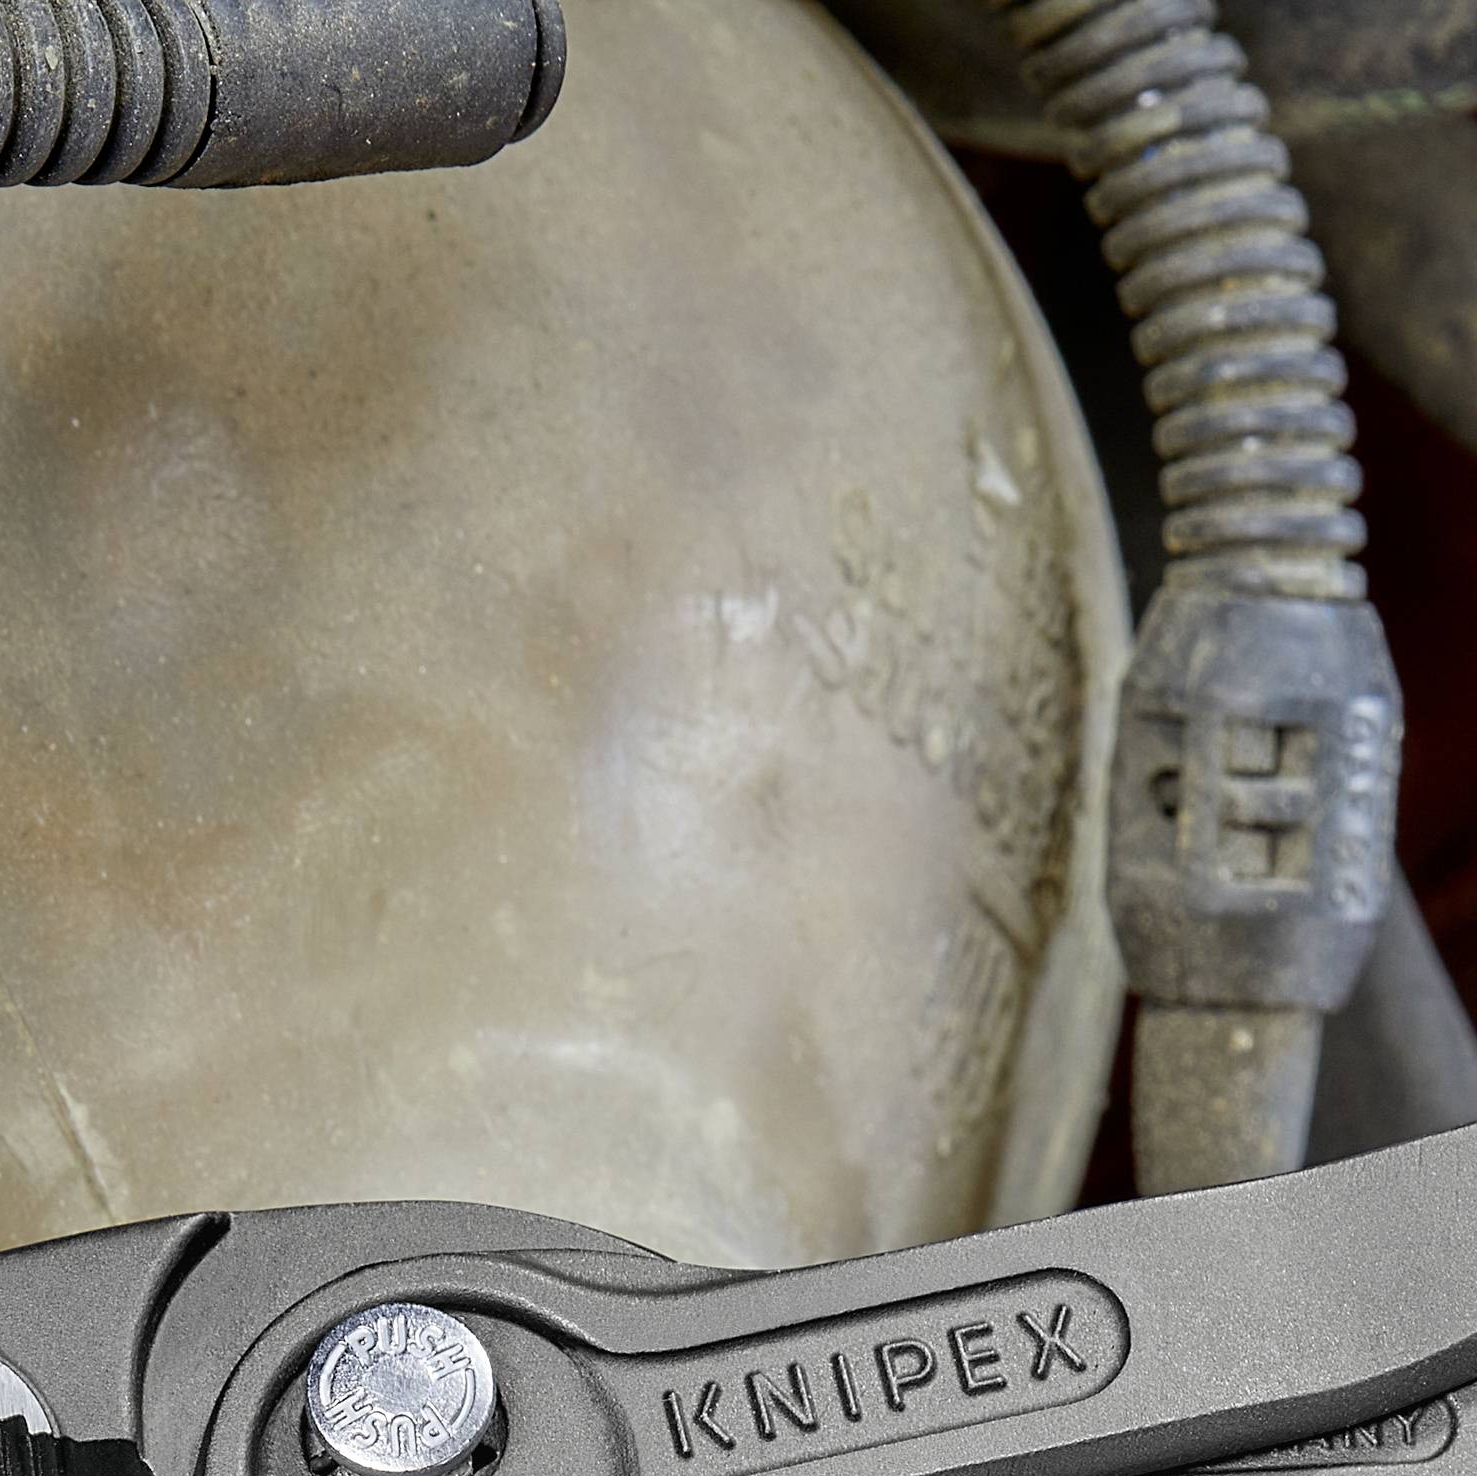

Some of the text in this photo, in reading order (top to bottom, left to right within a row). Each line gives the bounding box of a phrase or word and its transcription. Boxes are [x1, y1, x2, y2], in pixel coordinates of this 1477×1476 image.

[344, 1314, 472, 1383] PUSH
[662, 1303, 1088, 1458] KNIPEX
[324, 1385, 453, 1458] PUSH
